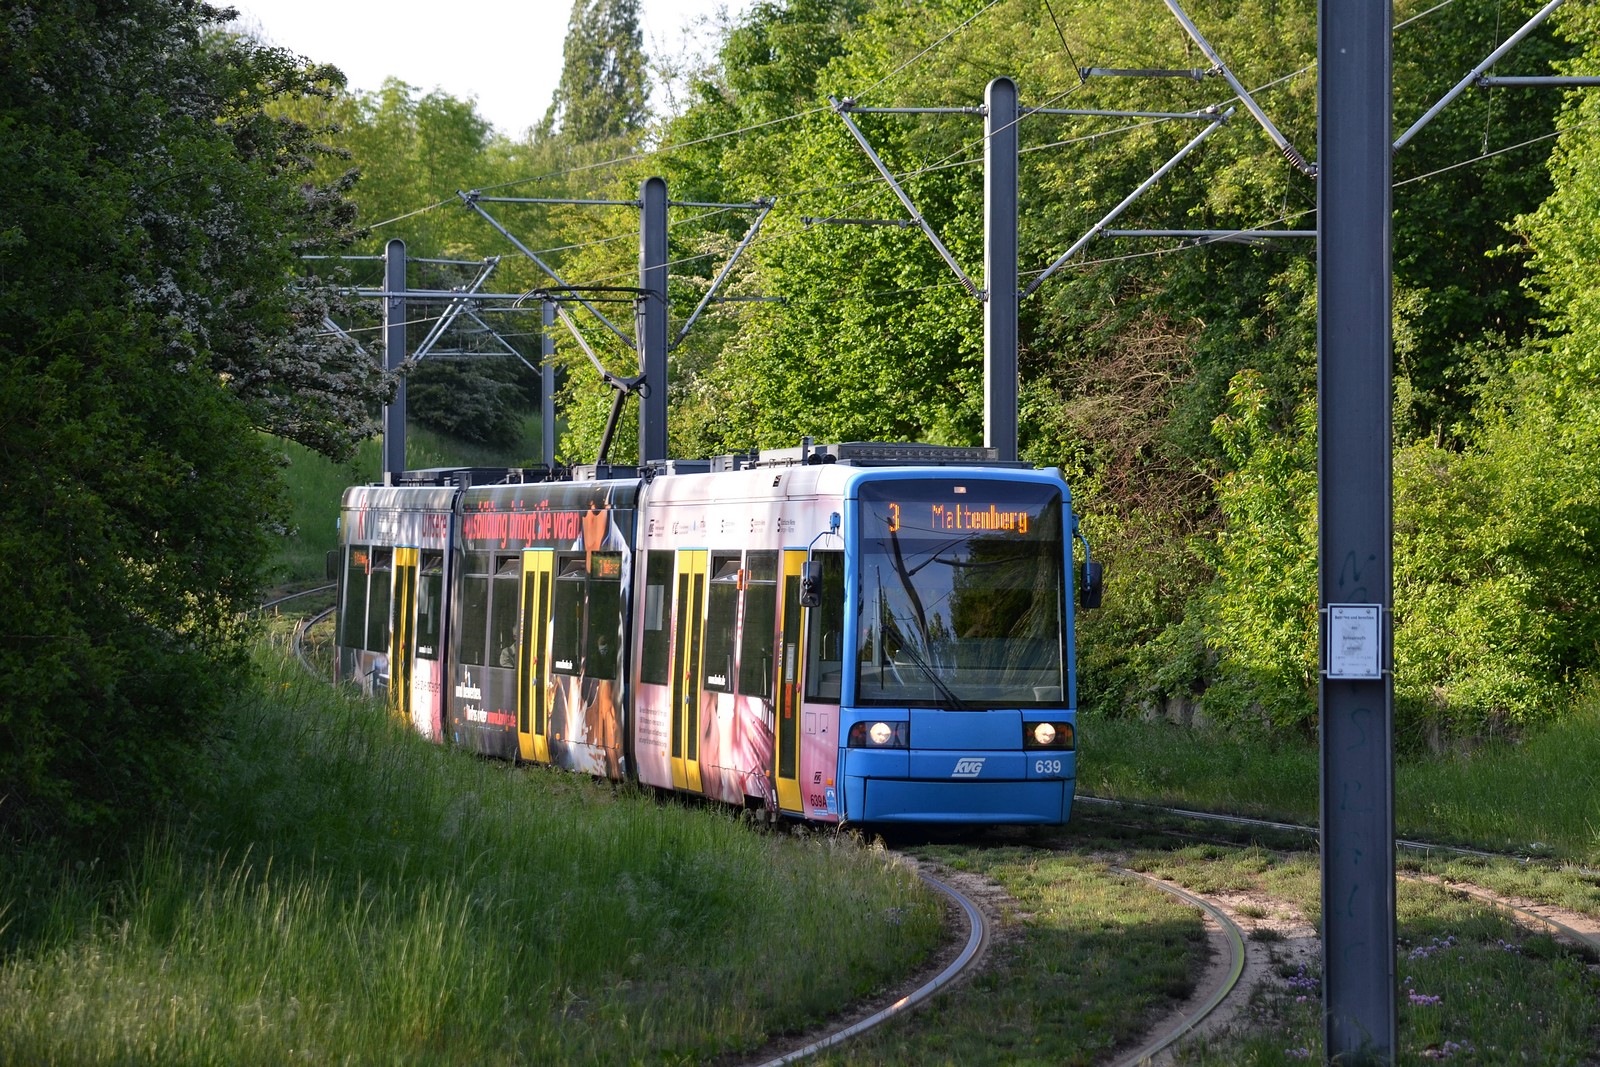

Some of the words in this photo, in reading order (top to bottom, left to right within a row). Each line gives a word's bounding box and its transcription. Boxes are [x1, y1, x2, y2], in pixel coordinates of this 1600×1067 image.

[509, 500, 537, 547] bringt
[537, 500, 551, 540] Sie
[889, 503, 900, 532] 3
[952, 761, 984, 775] KVG
[1035, 760, 1061, 774] 639
[810, 794, 827, 808] 639A
